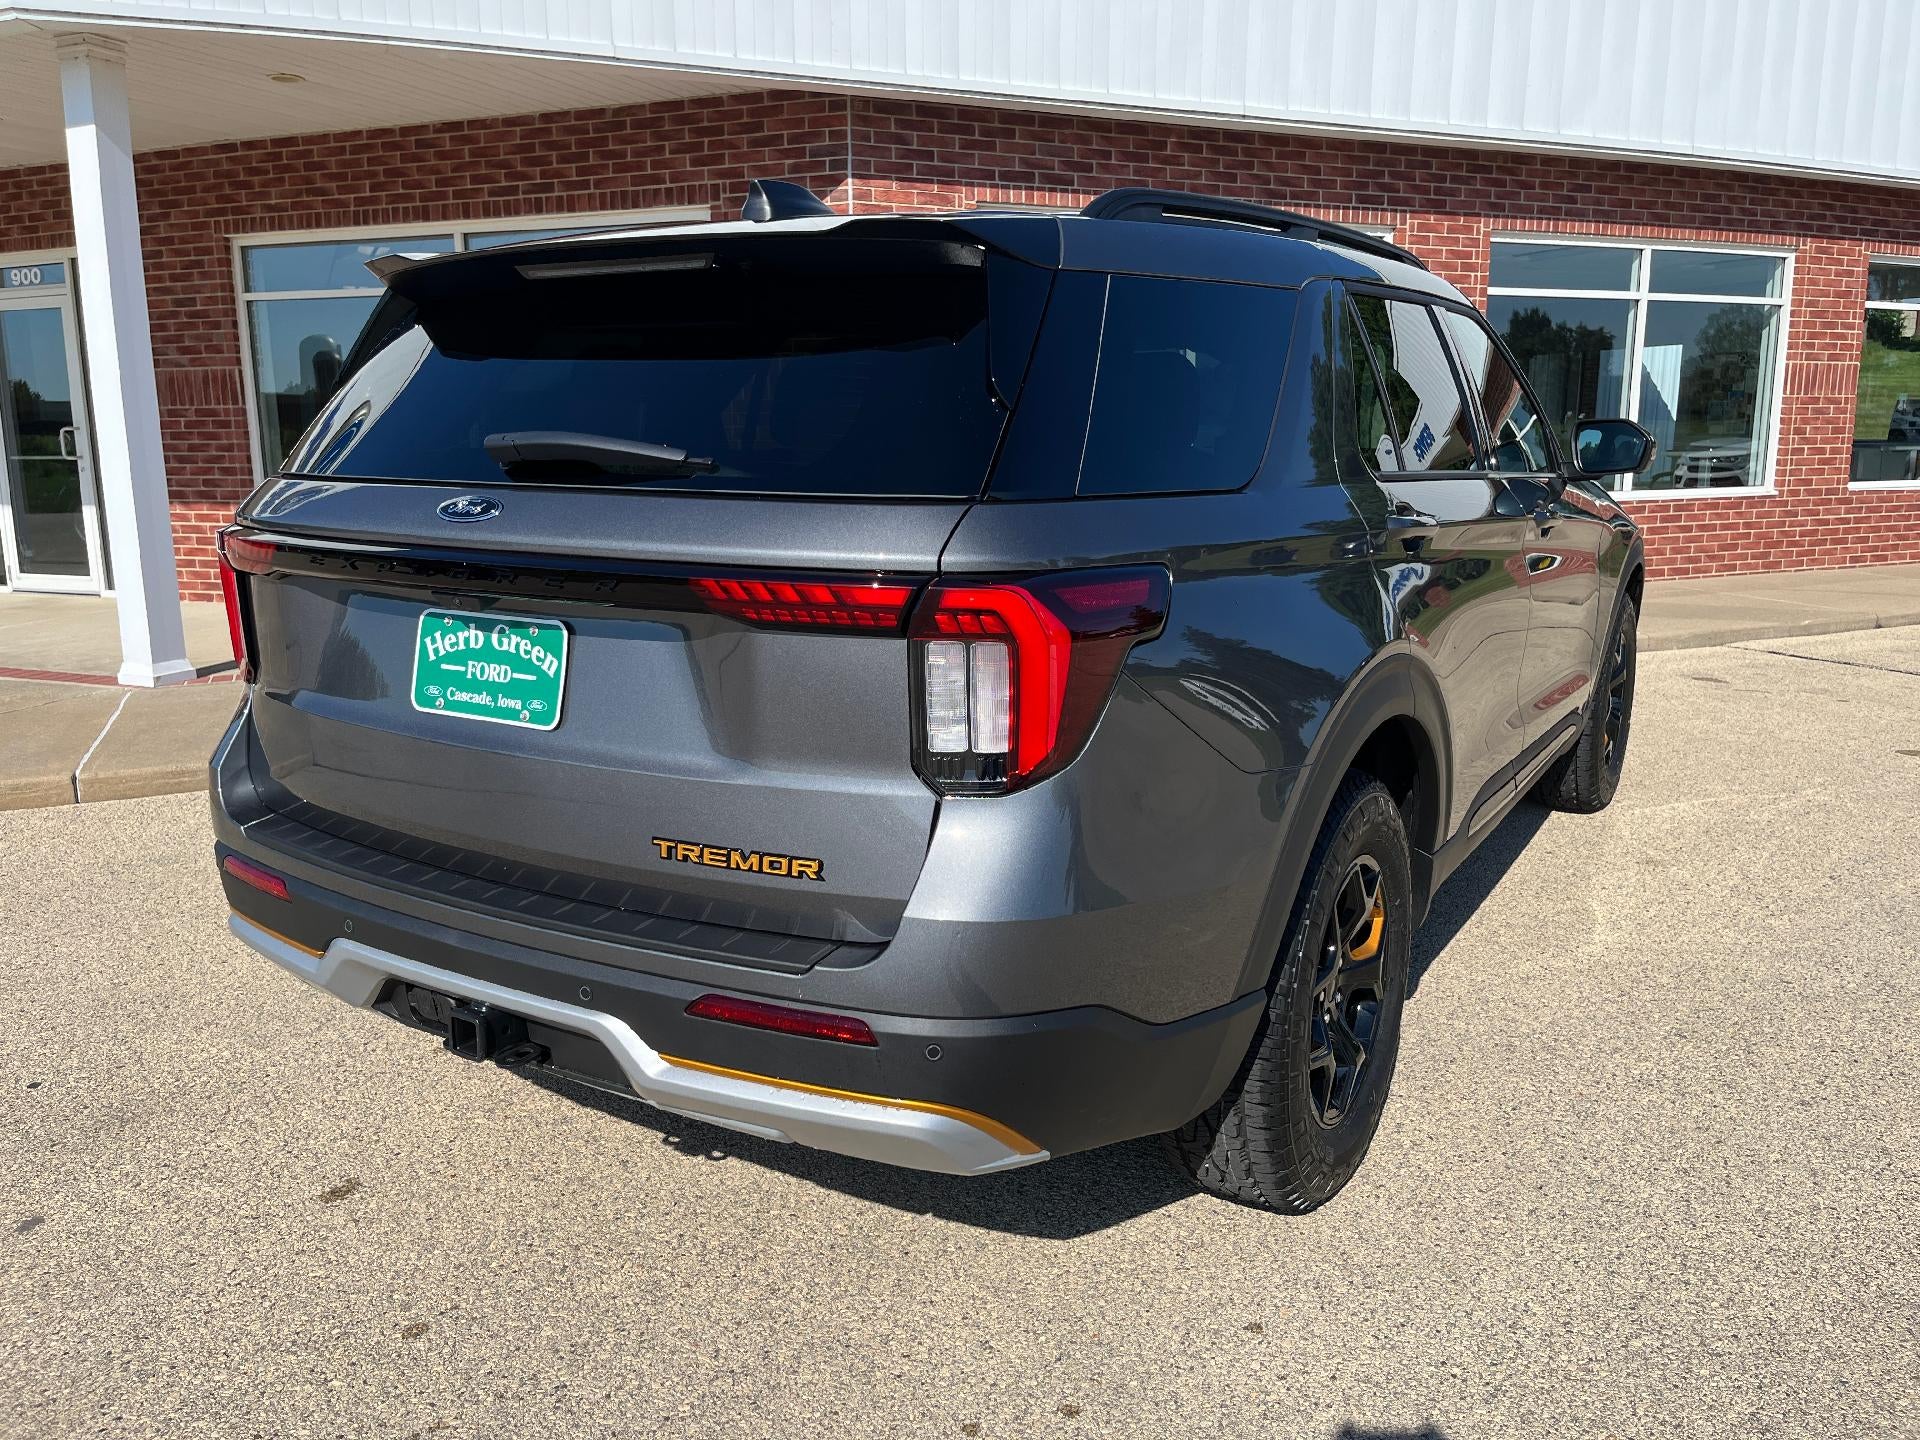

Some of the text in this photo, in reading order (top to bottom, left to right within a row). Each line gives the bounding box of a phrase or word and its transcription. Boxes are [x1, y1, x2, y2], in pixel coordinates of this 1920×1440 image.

[11, 268, 40, 286] 900
[424, 624, 559, 678] Herb Green
[466, 660, 512, 683] FORD
[446, 687, 522, 710] Cascade, Iowa
[652, 837, 825, 881] TREMOR
